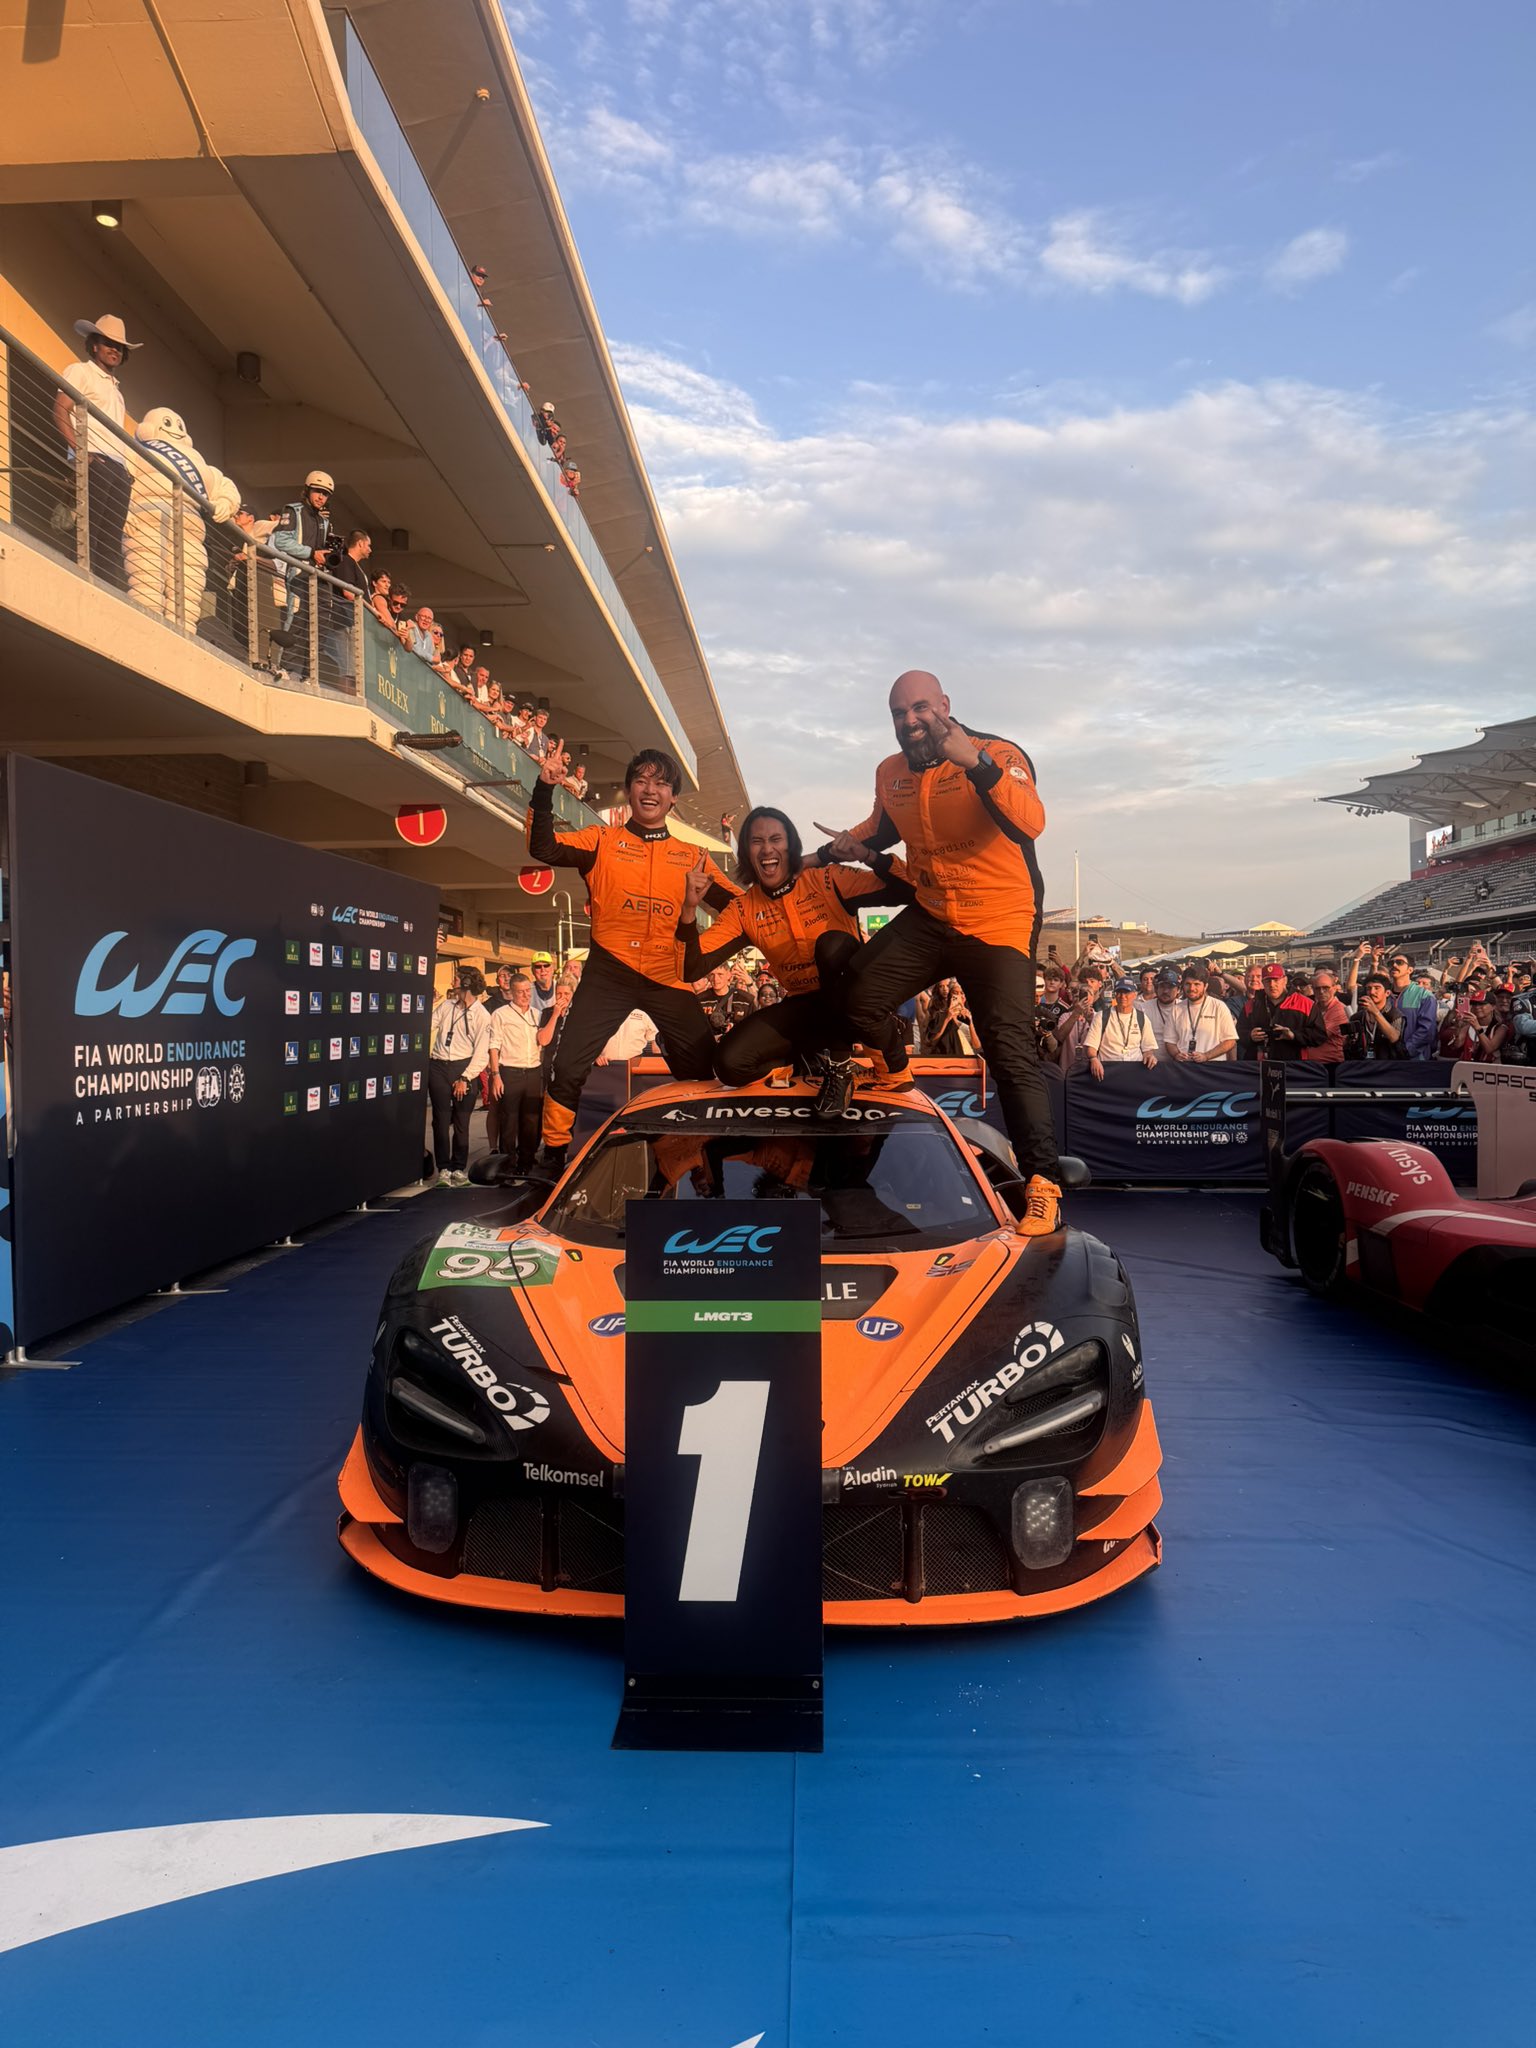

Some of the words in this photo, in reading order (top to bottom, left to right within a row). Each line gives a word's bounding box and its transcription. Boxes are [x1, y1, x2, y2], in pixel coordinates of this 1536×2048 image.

[378, 673, 409, 714] ROLEX
[532, 870, 541, 888] 2
[622, 898, 674, 917] AERO
[804, 912, 828, 928] Aladin
[75, 930, 257, 1018] WEC
[75, 1046, 102, 1068] FIA
[107, 1043, 163, 1065] WORLD
[167, 1040, 246, 1062] ENDURANCE
[75, 1068, 194, 1098] CHAMPIONSHIP
[76, 1111, 84, 1126] A
[94, 1098, 193, 1123] PARTNERSHIP
[706, 1106, 812, 1119] Invesc
[934, 1091, 995, 1118] EC
[1136, 1091, 1257, 1119] WEC
[1136, 1131, 1209, 1139] CHAMPIONSHIP
[1190, 1123, 1248, 1131] ENDURANCE
[1406, 1132, 1479, 1140] CHAMPIONSHIP
[1346, 1182, 1399, 1206] PENSKE
[664, 1225, 782, 1254] WEC
[436, 1253, 543, 1282] 95
[821, 1282, 858, 1301] LE
[694, 1312, 753, 1322] LMGT3
[862, 1320, 899, 1336] UP
[448, 1315, 487, 1354] PERTAMAX
[430, 1318, 517, 1411] TURBO
[925, 1379, 981, 1428] PERTAMAX
[931, 1343, 1047, 1444] TURBO
[523, 1462, 604, 1488] Telkomsel
[843, 1466, 898, 1487] Aladin
[903, 1473, 939, 1488] TOW
[678, 1381, 770, 1601] 1
